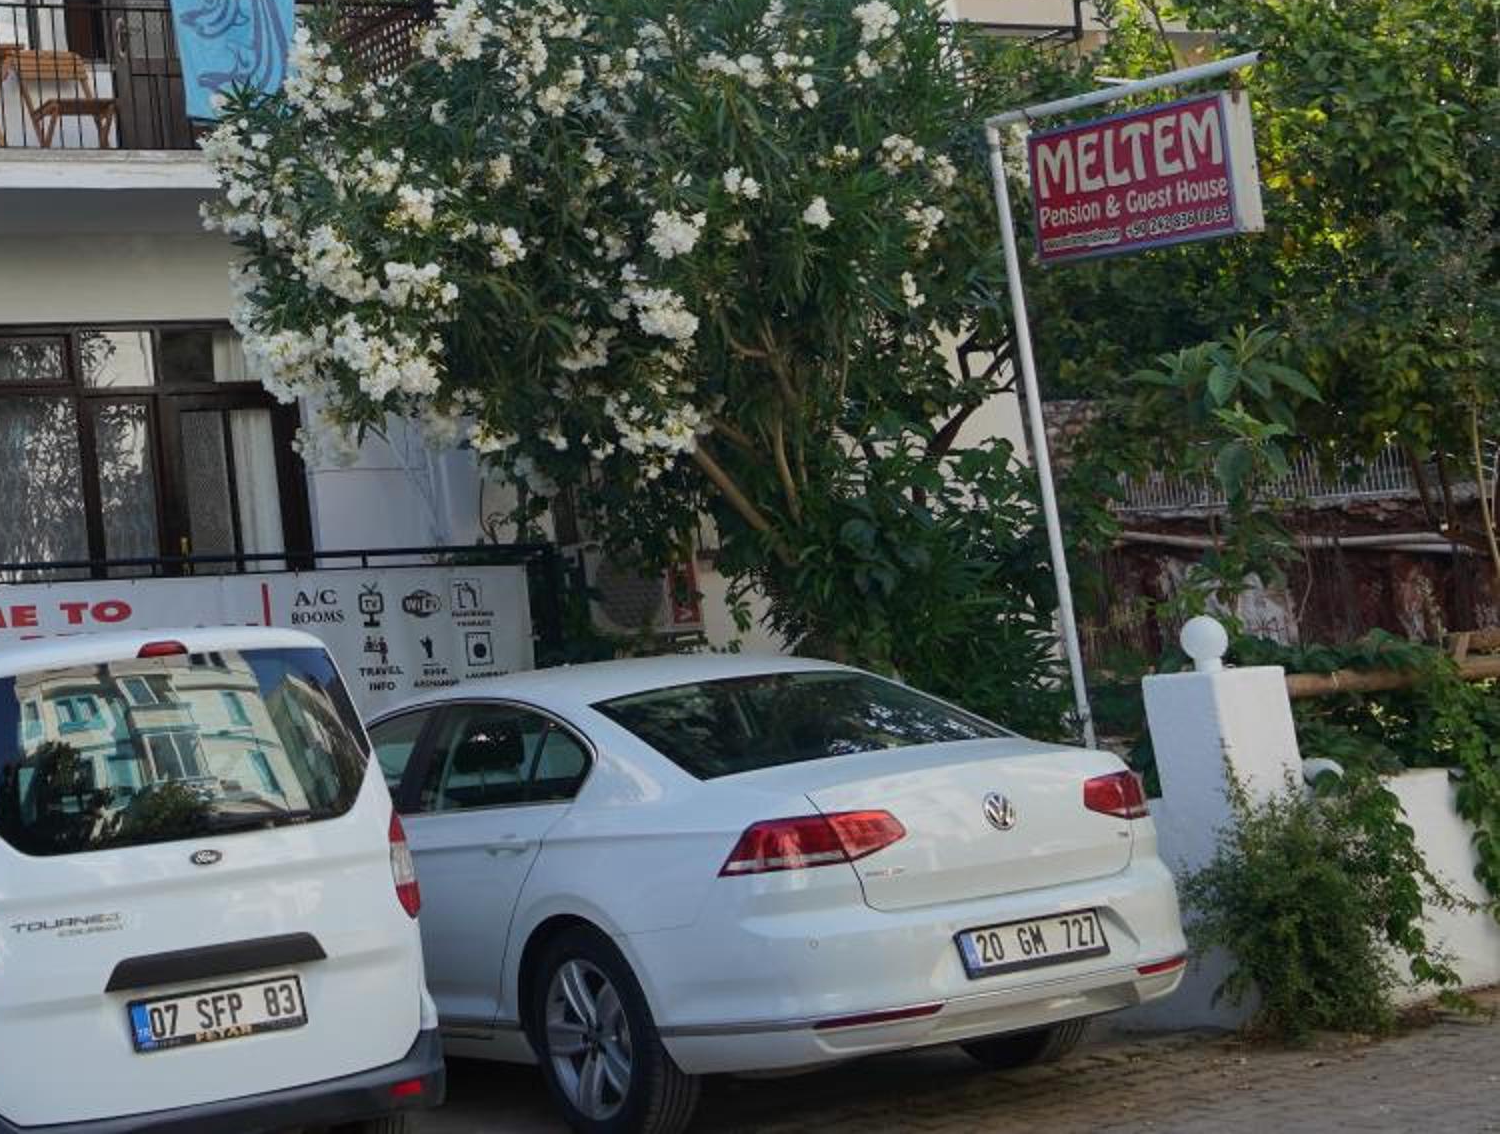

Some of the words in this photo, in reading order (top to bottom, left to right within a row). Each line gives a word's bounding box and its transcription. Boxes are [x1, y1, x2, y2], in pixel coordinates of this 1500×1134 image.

[1036, 105, 1223, 198] MELTEM
[1039, 201, 1101, 228] Pension
[1105, 193, 1121, 217] &
[1125, 186, 1172, 213] Guest
[1176, 177, 1229, 204] House
[294, 587, 338, 607] A/C
[59, 599, 133, 625] TO
[291, 609, 345, 625] ROOMS
[358, 666, 405, 677] TRAVEL
[369, 681, 396, 692] INFO
[976, 931, 1005, 963] 20
[1017, 922, 1047, 956] GM
[1059, 916, 1096, 949] 727
[150, 1003, 179, 1039] 07
[196, 992, 243, 1029] SFP
[263, 984, 297, 1017] 83
